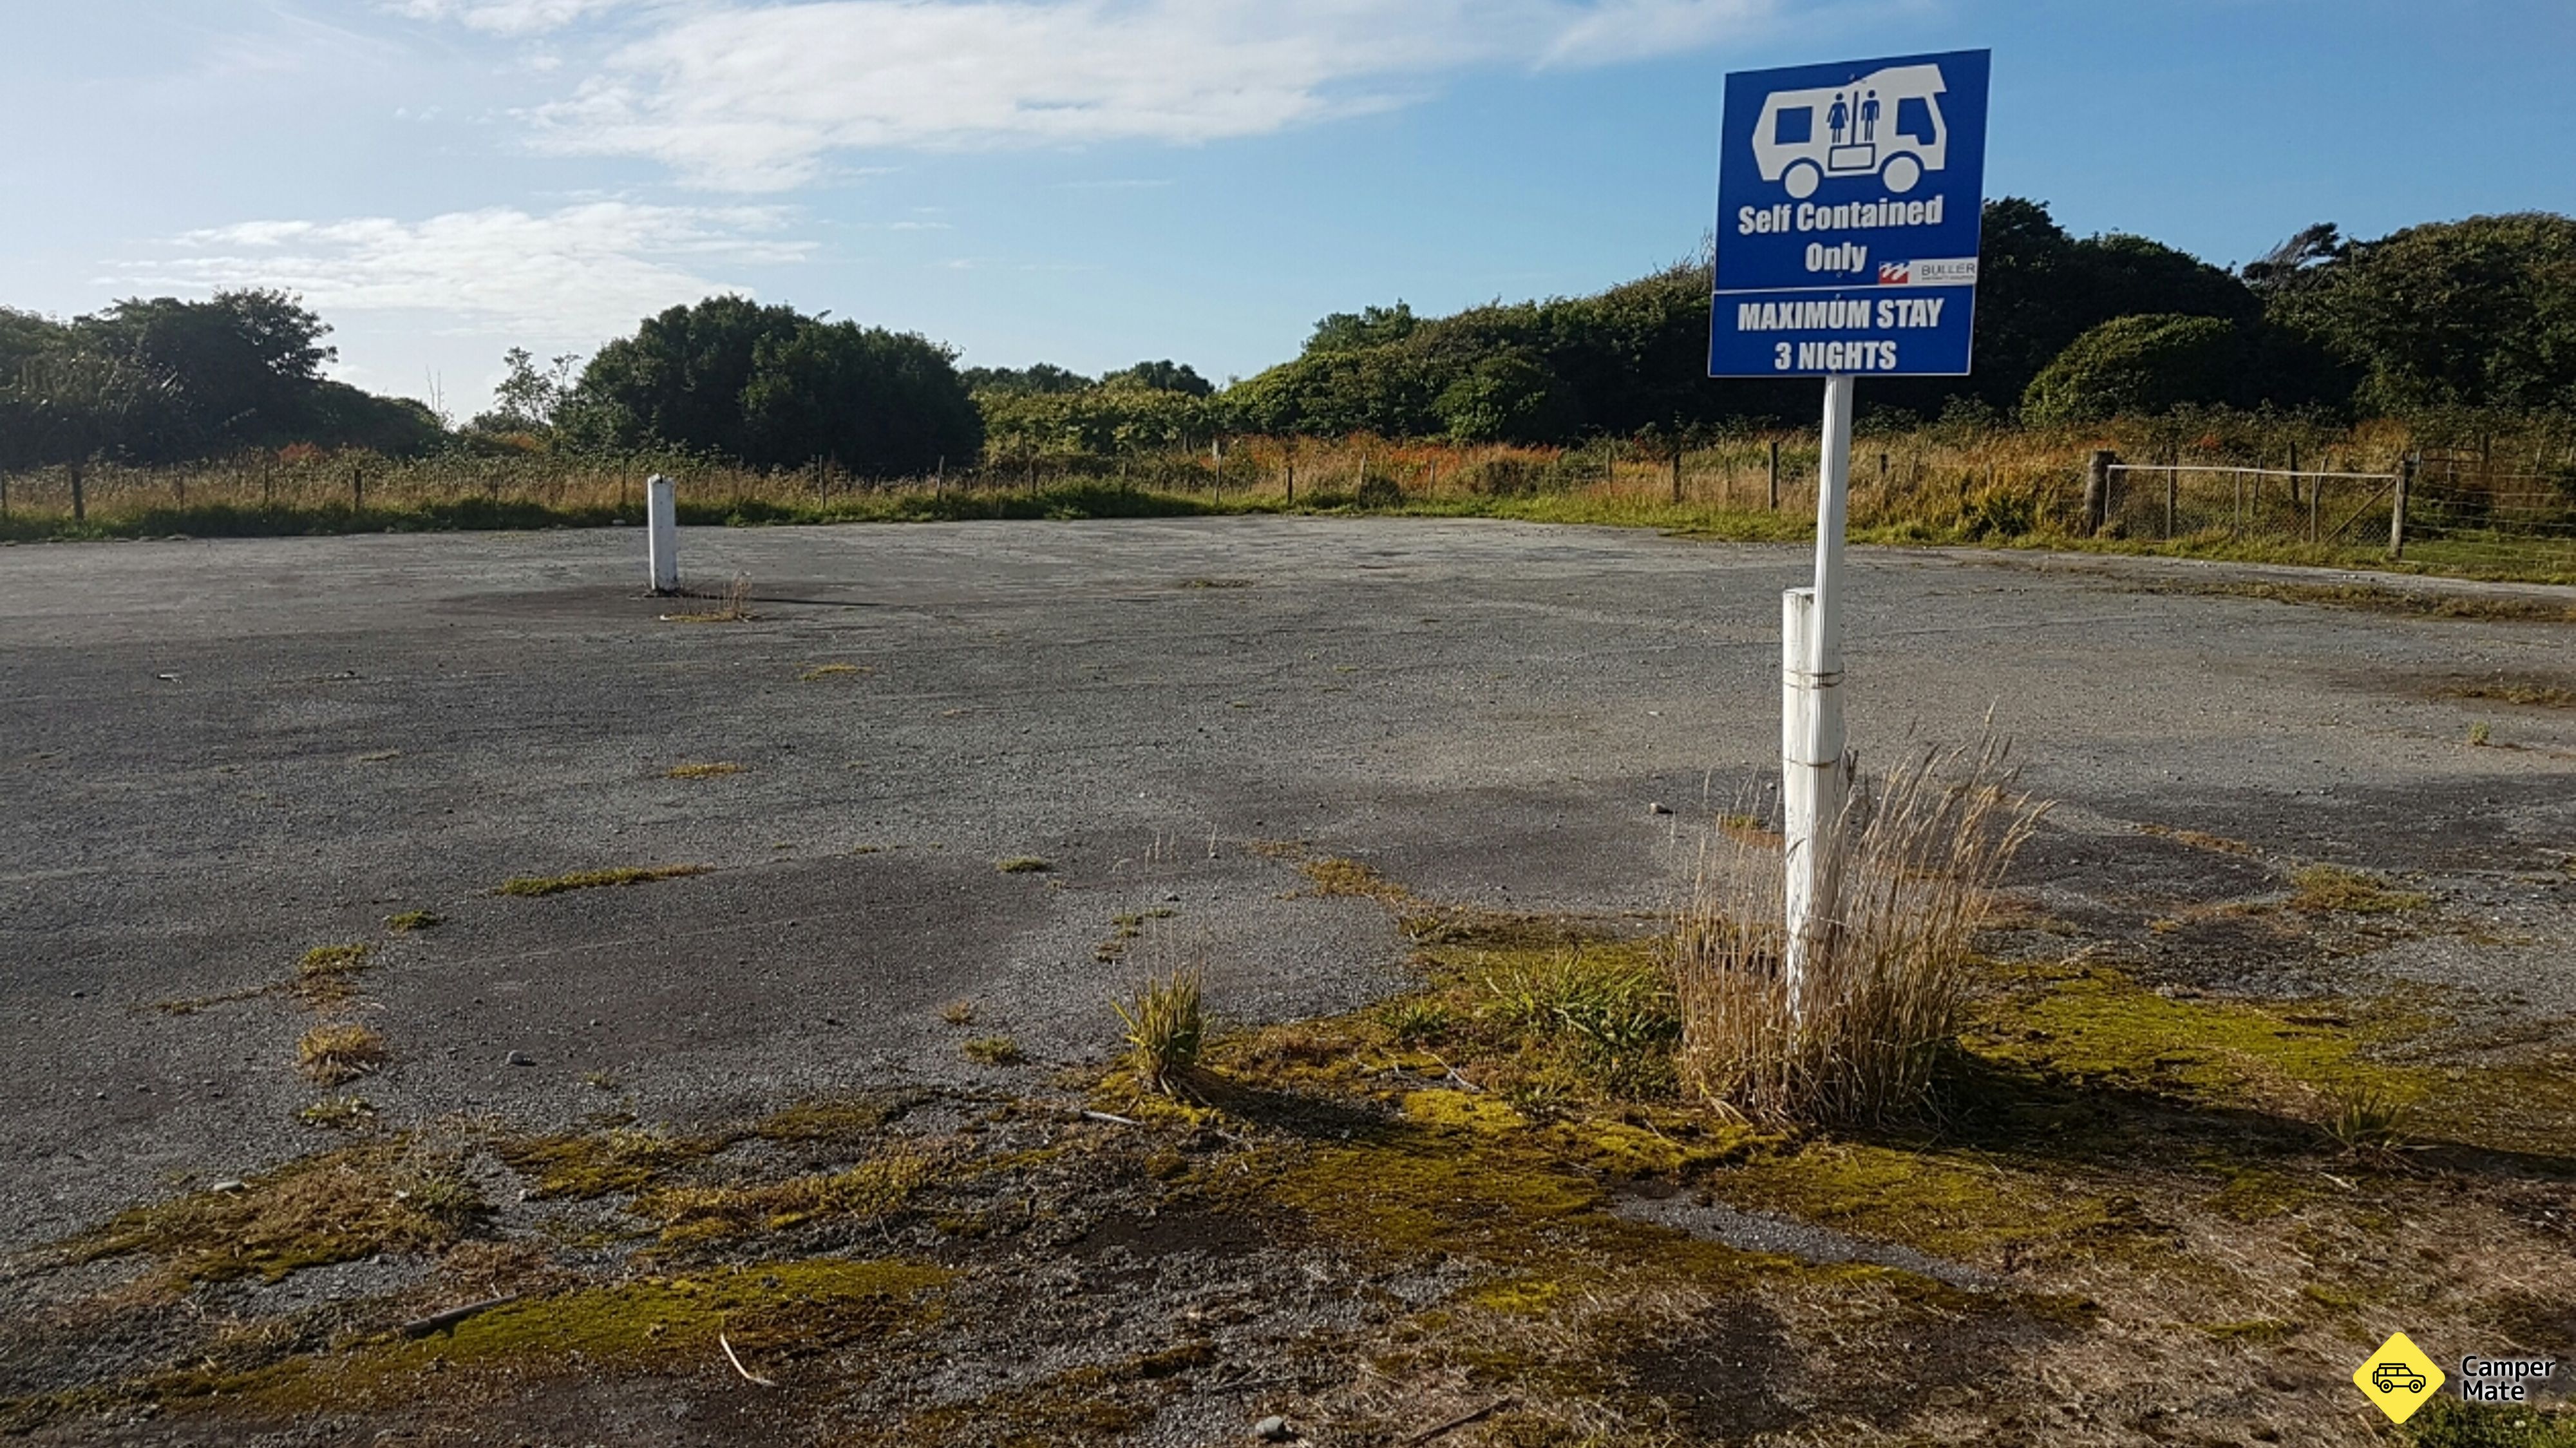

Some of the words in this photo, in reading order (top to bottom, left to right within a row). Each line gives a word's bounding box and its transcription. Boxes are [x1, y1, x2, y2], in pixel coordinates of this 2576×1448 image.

[1738, 204, 1792, 234] Self
[1797, 195, 1944, 231] Contained
[1805, 242, 1867, 272] Only
[1921, 263, 1976, 276] BULLER
[1738, 300, 1871, 330] MAXIMUM
[1876, 298, 1945, 327] STAY
[1774, 342, 1792, 370] 3
[1797, 341, 1897, 370] NIGHTS
